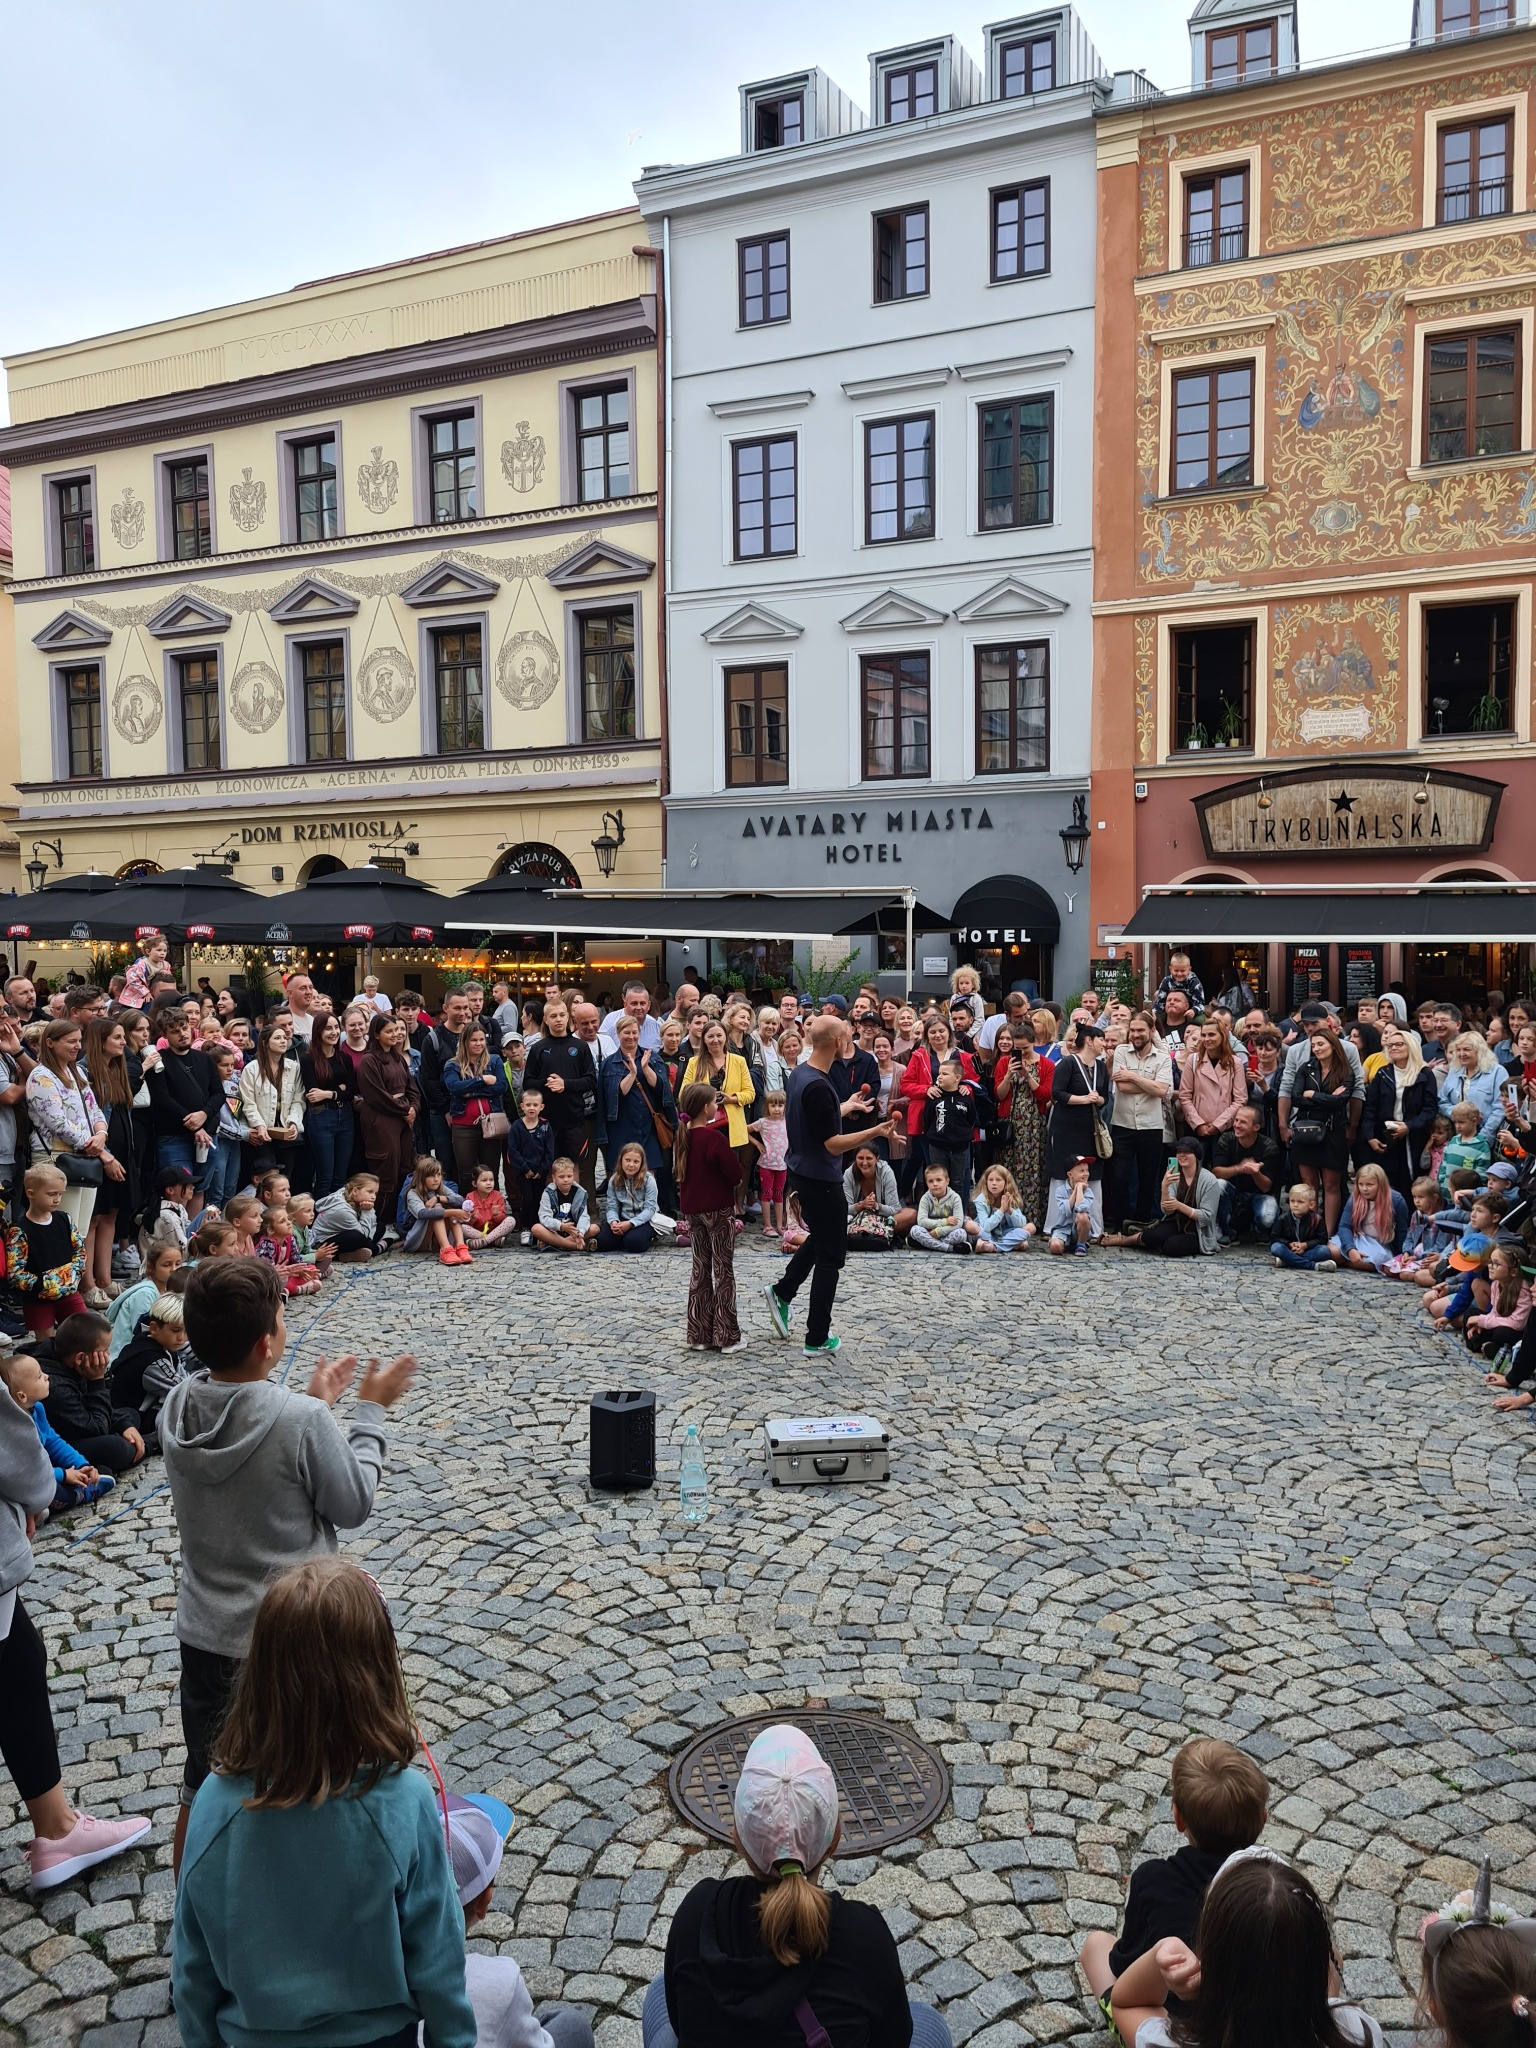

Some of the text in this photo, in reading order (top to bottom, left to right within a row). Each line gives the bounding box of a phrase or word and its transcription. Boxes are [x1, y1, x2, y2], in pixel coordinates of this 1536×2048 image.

[42, 791, 72, 804] DOM
[78, 789, 109, 803] ONGI
[116, 783, 200, 800] SEBASTIANA
[216, 776, 309, 794] KLONOWICZA
[408, 763, 468, 781] AUTORA
[478, 761, 522, 777] FLISA
[241, 820, 406, 844] DOM RZEMIOSŁA
[742, 807, 994, 838] AVATARY MIASTA
[1249, 812, 1443, 844] TRYBUNALSKA
[508, 852, 562, 872] PIZZA PUB
[826, 843, 902, 864] HOTEL
[958, 929, 1031, 943] HOTEL
[1298, 948, 1318, 957] PIZZA
